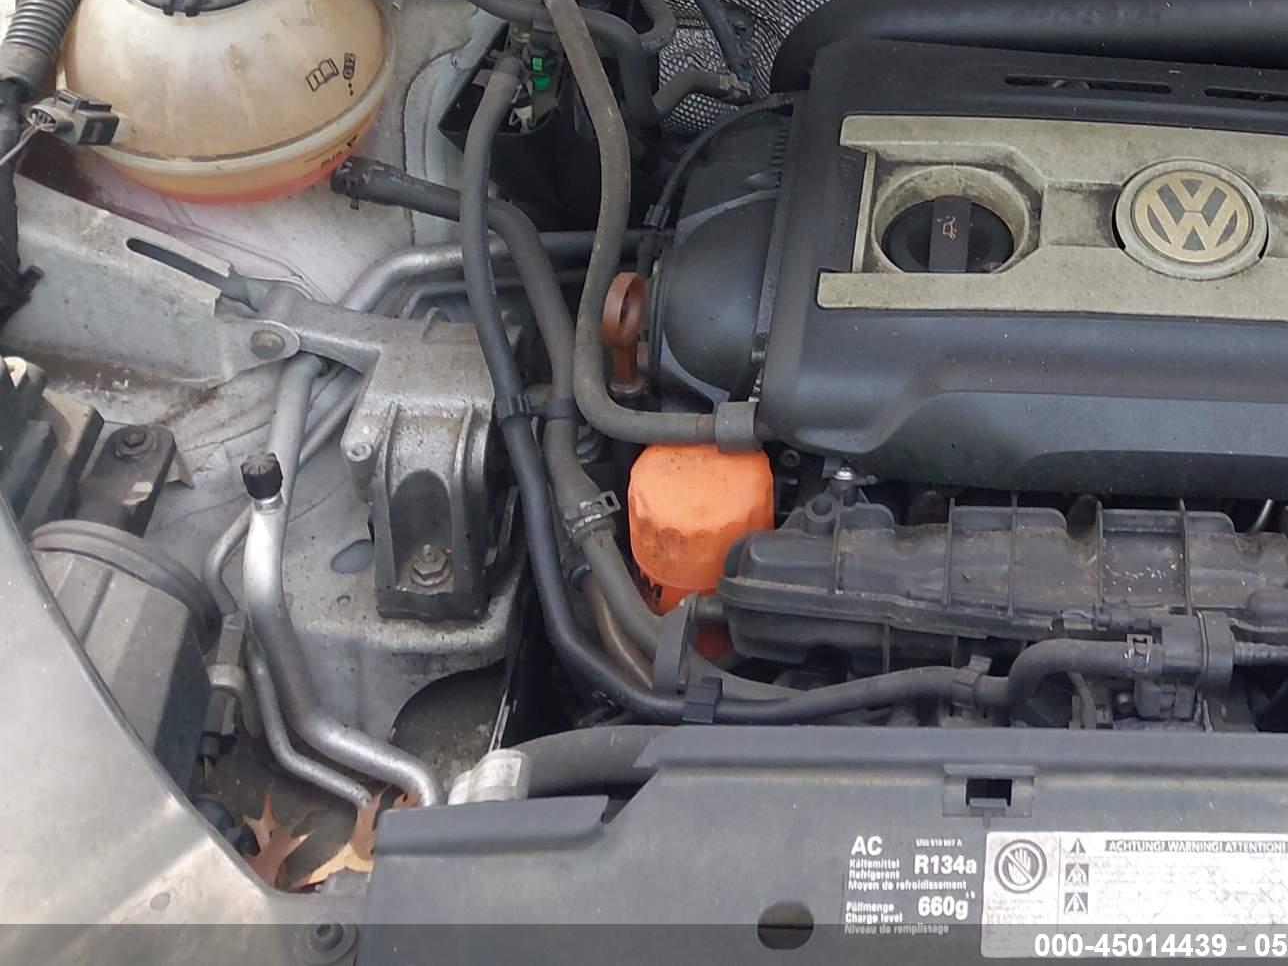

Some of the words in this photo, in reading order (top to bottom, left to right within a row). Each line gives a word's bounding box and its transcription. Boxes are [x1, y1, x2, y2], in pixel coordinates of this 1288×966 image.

[851, 835, 882, 856] AC
[914, 854, 977, 875] R134a
[849, 869, 900, 881] Refrigerant
[848, 880, 879, 892] Moyen
[881, 881, 894, 890] de
[896, 880, 967, 890] refroidissement
[918, 895, 969, 920] 660g
[845, 912, 878, 924] Charge
[880, 912, 902, 923] level
[844, 924, 877, 935] Niveau
[879, 924, 892, 934] de
